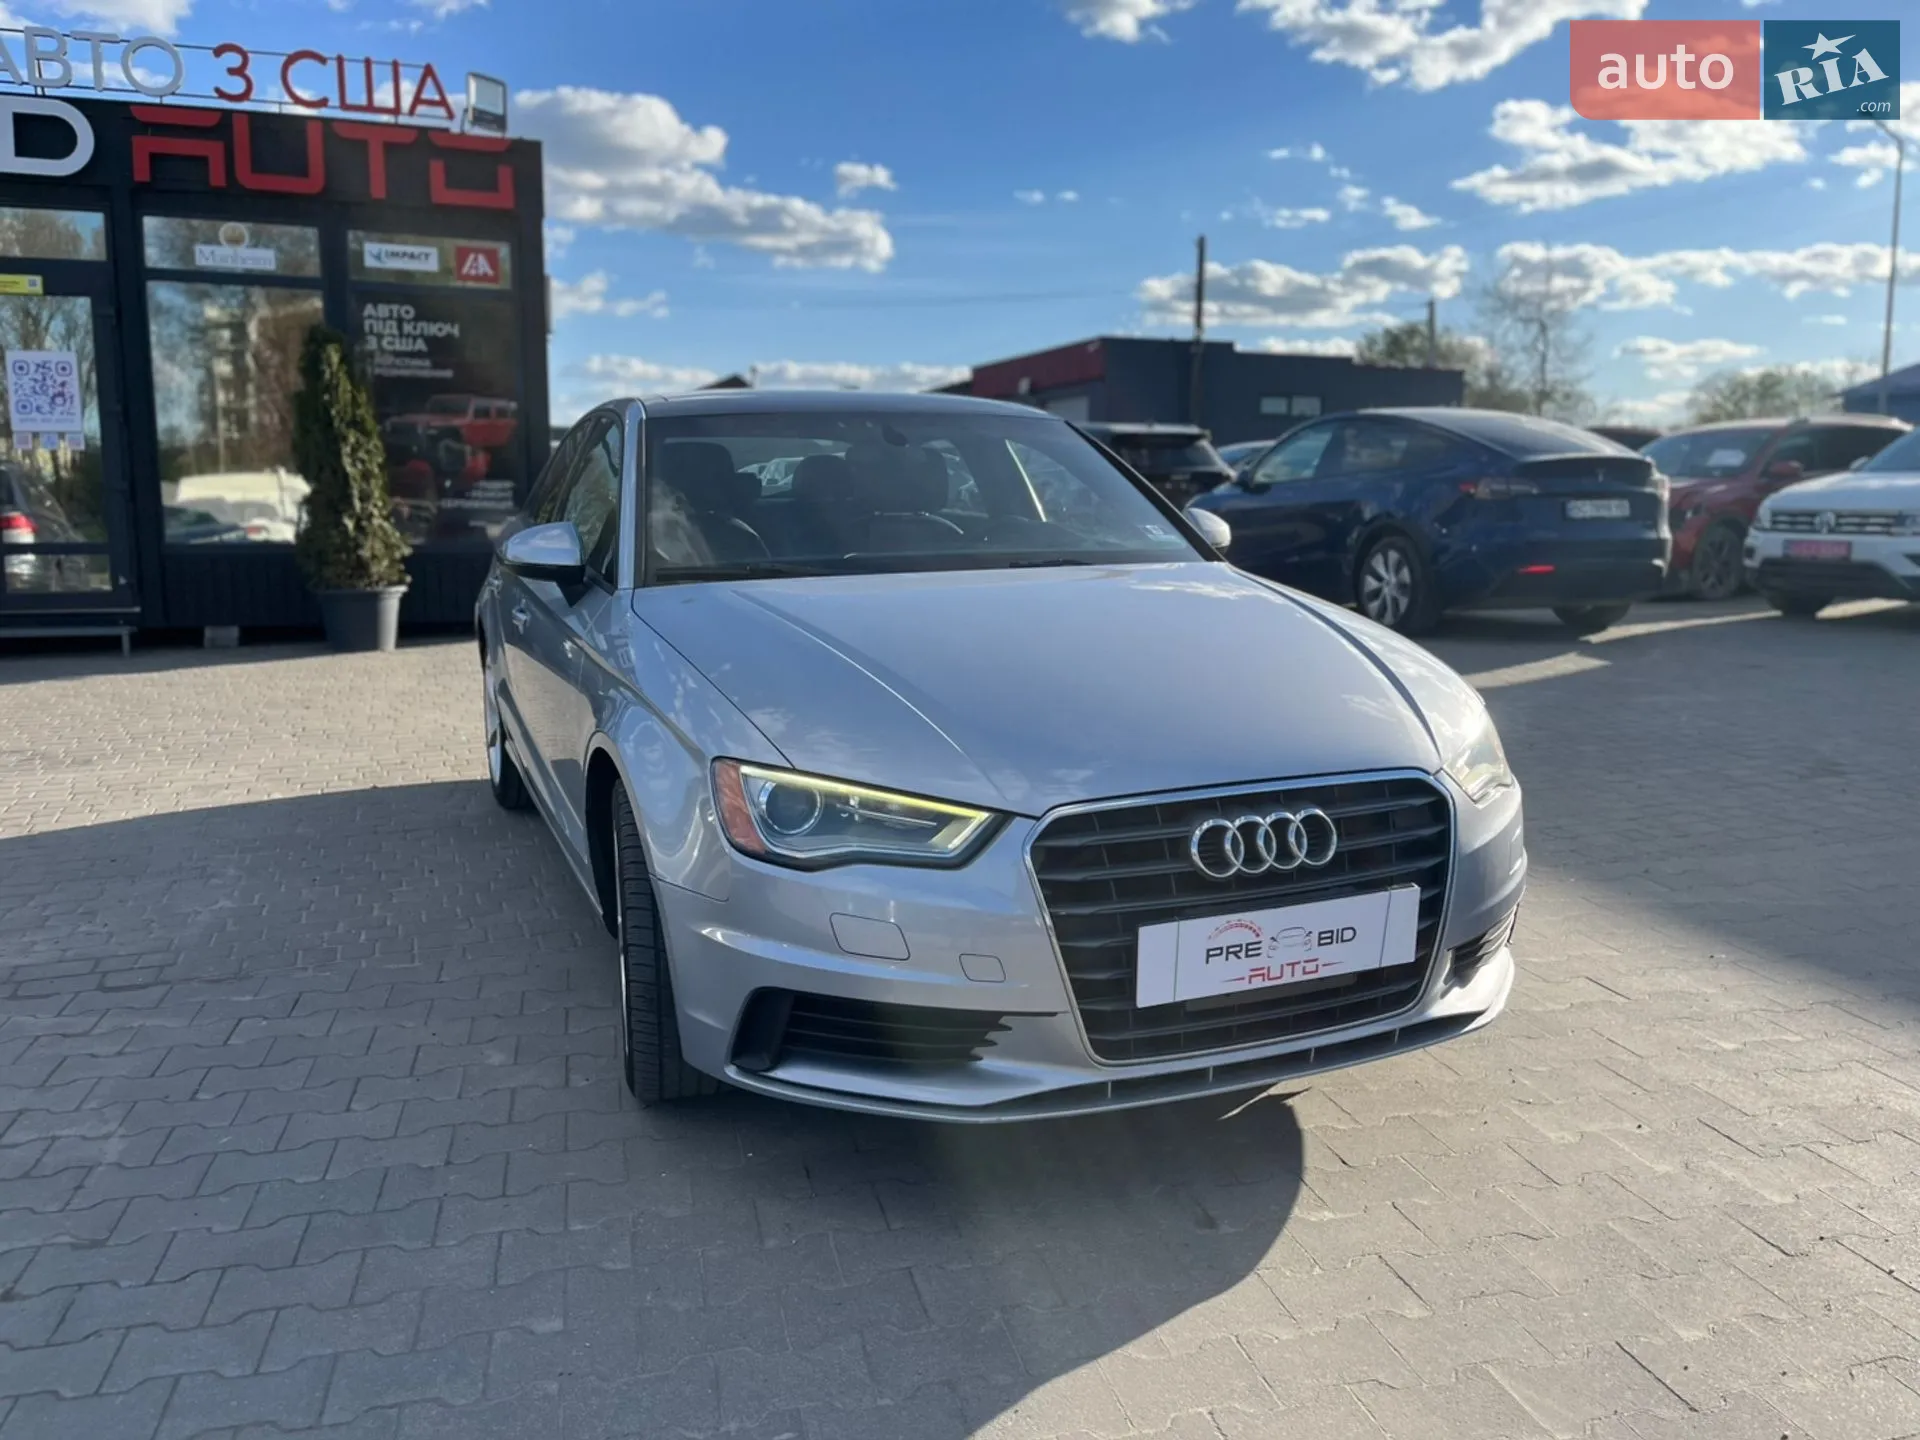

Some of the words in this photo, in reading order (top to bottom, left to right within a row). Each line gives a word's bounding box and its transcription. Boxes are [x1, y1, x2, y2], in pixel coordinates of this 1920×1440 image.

[280, 49, 455, 120] США
[130, 105, 516, 209] AUTO
[363, 303, 416, 320] АВТО
[364, 319, 399, 336] ПІД
[403, 321, 461, 338] КЛЮЧ
[382, 336, 428, 352] США
[1205, 940, 1263, 965] PRE
[1317, 926, 1357, 947] BID
[1248, 958, 1320, 985] AUTO
